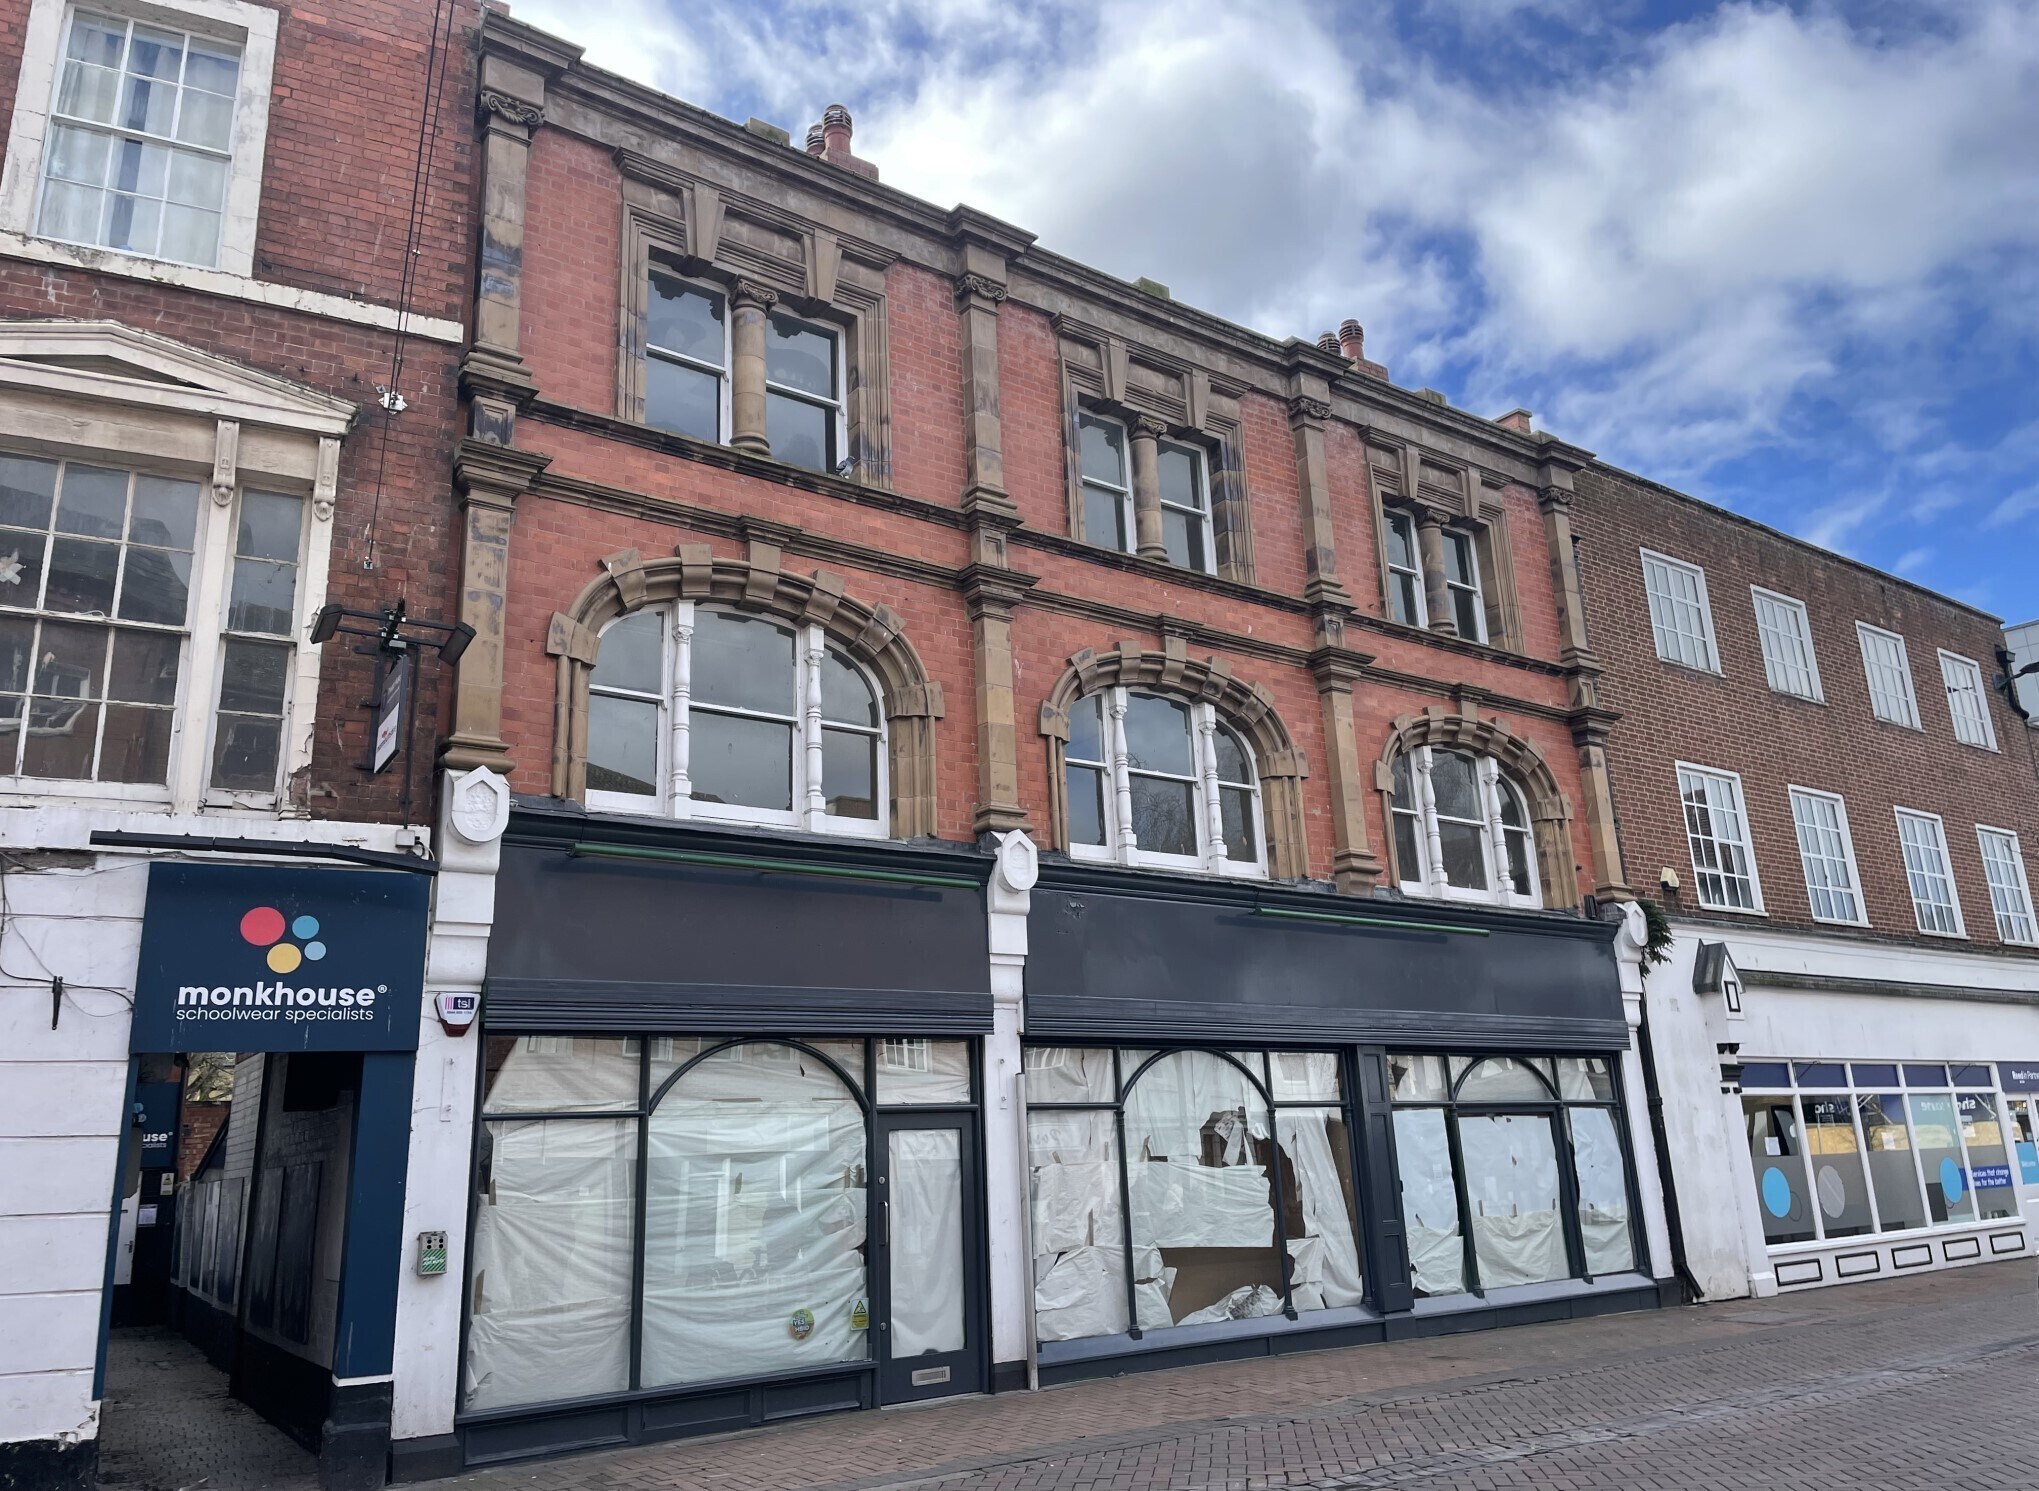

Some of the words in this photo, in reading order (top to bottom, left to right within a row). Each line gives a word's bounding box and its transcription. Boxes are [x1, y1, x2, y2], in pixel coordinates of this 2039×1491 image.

[176, 1007, 280, 1021] schoolwear
[285, 1008, 374, 1024] specialists
[1972, 1169, 1987, 1178] ervices
